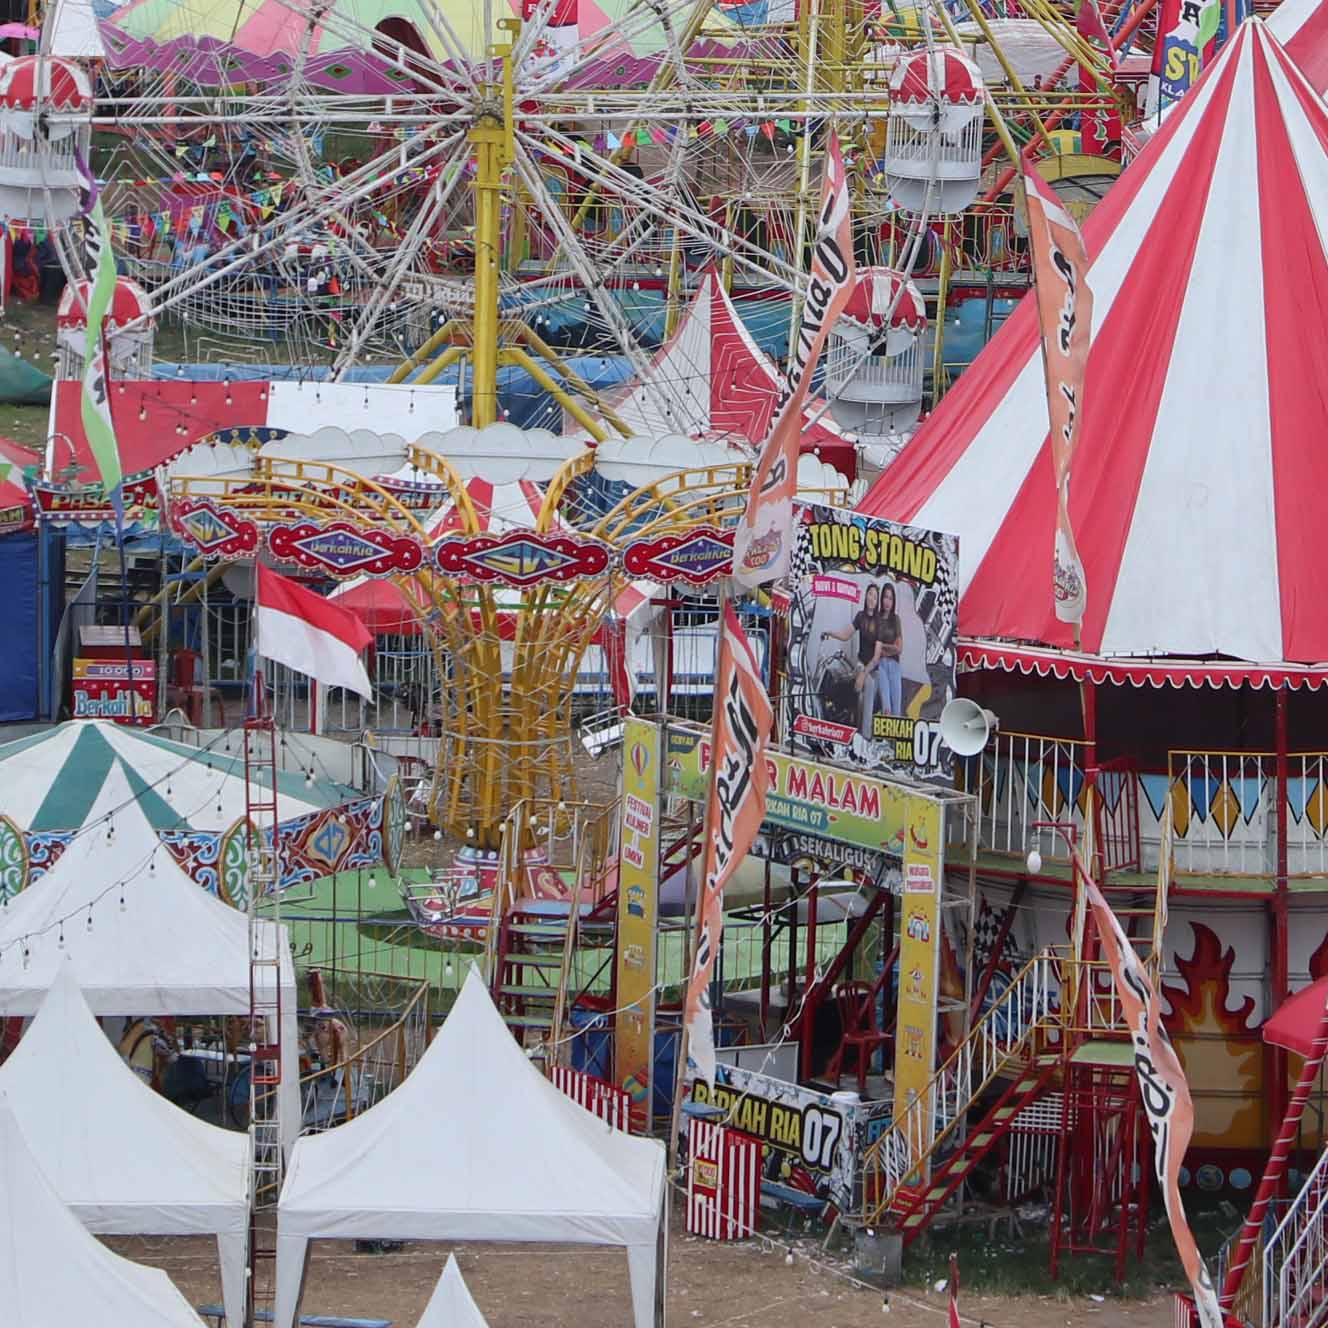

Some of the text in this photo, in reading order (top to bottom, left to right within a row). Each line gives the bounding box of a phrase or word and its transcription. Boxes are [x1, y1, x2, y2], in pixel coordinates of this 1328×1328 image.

[809, 524, 861, 561] TONG
[865, 529, 939, 584] STAND
[874, 718, 943, 766] BERKAH 07
[896, 741, 912, 761] RIA
[787, 765, 881, 821] MALAM
[792, 805, 809, 821] RIA
[811, 812, 823, 825] 07
[771, 1106, 800, 1148] RIA
[802, 1106, 842, 1169] 07
